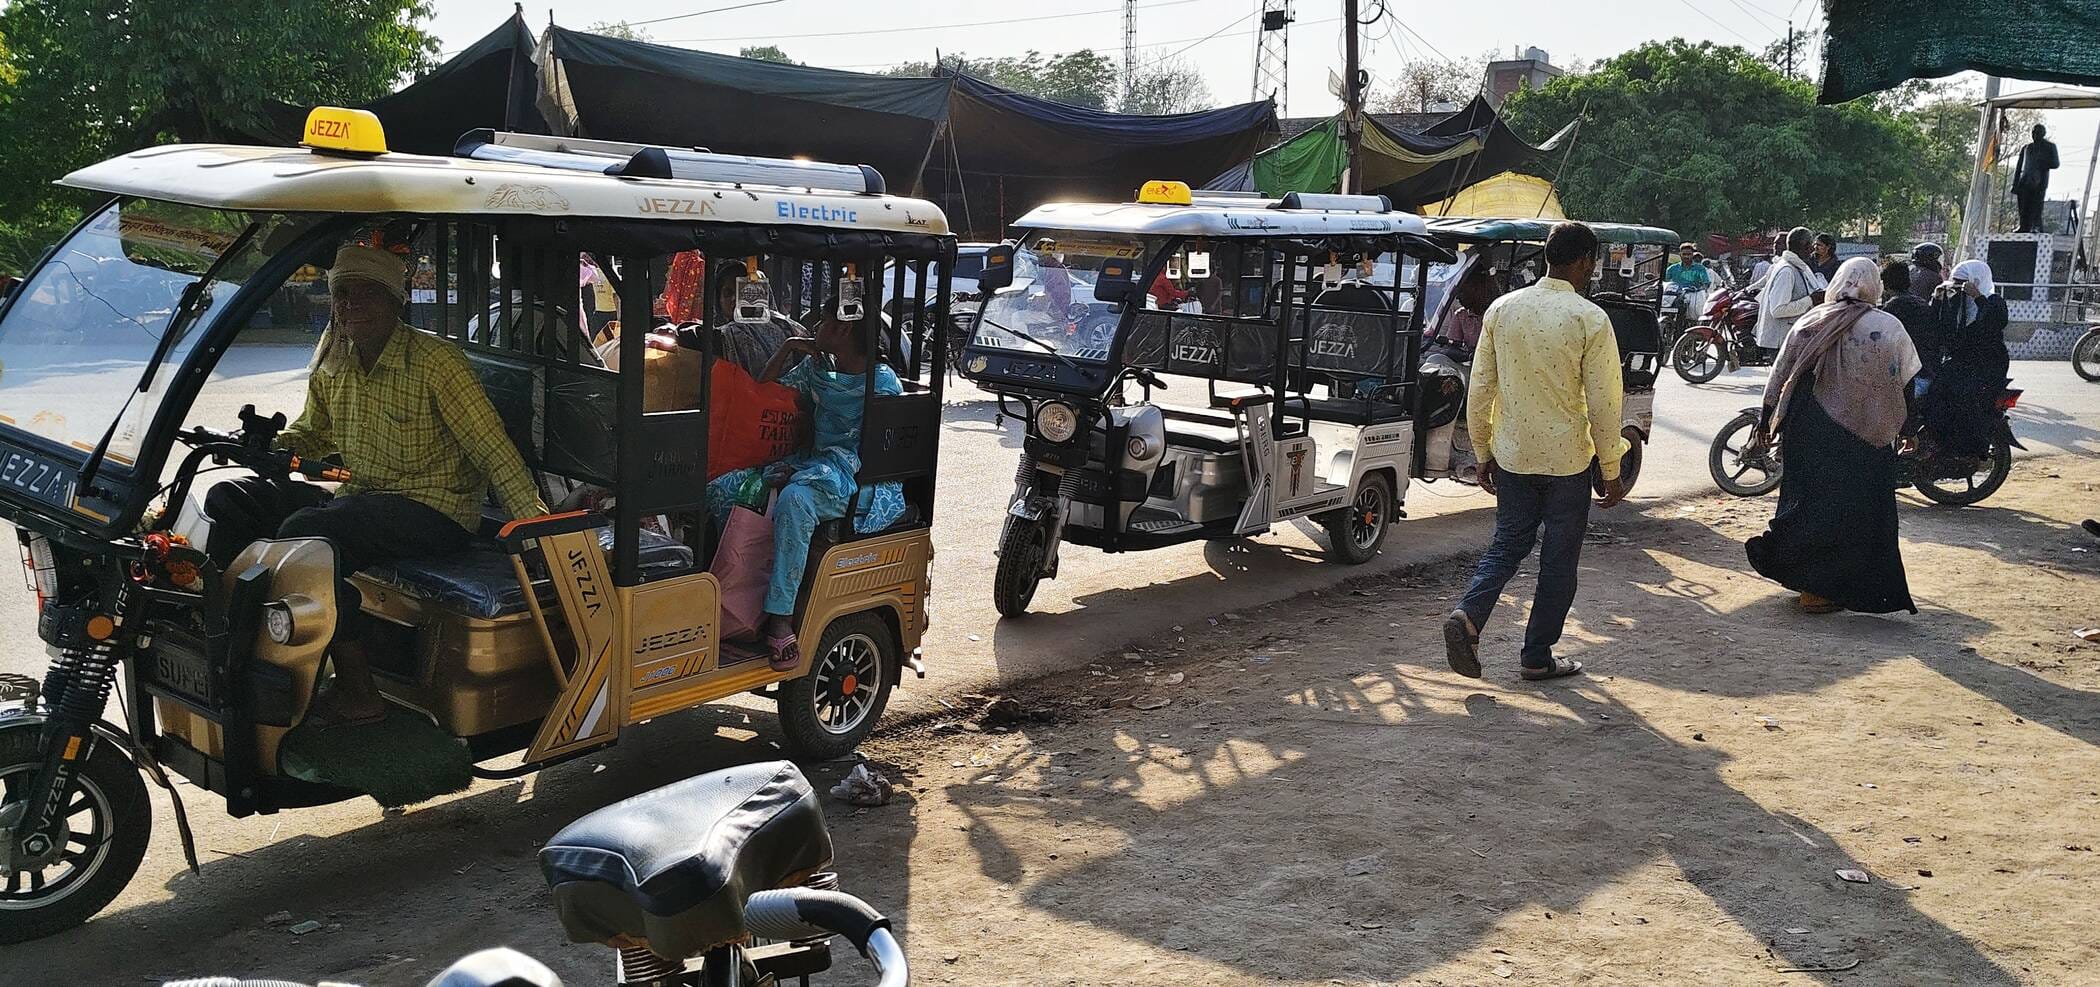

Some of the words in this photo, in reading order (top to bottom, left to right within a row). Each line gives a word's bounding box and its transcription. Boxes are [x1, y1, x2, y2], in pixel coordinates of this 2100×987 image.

[310, 119, 350, 139] JEZZA
[638, 197, 716, 216] JEZZA
[776, 201, 857, 224] Electric
[1171, 344, 1219, 365] JEZZA
[1310, 340, 1355, 359] JEZZA
[567, 549, 602, 619] JEZZA
[634, 624, 710, 655] JEZZA
[37, 764, 69, 830] JEZZA
